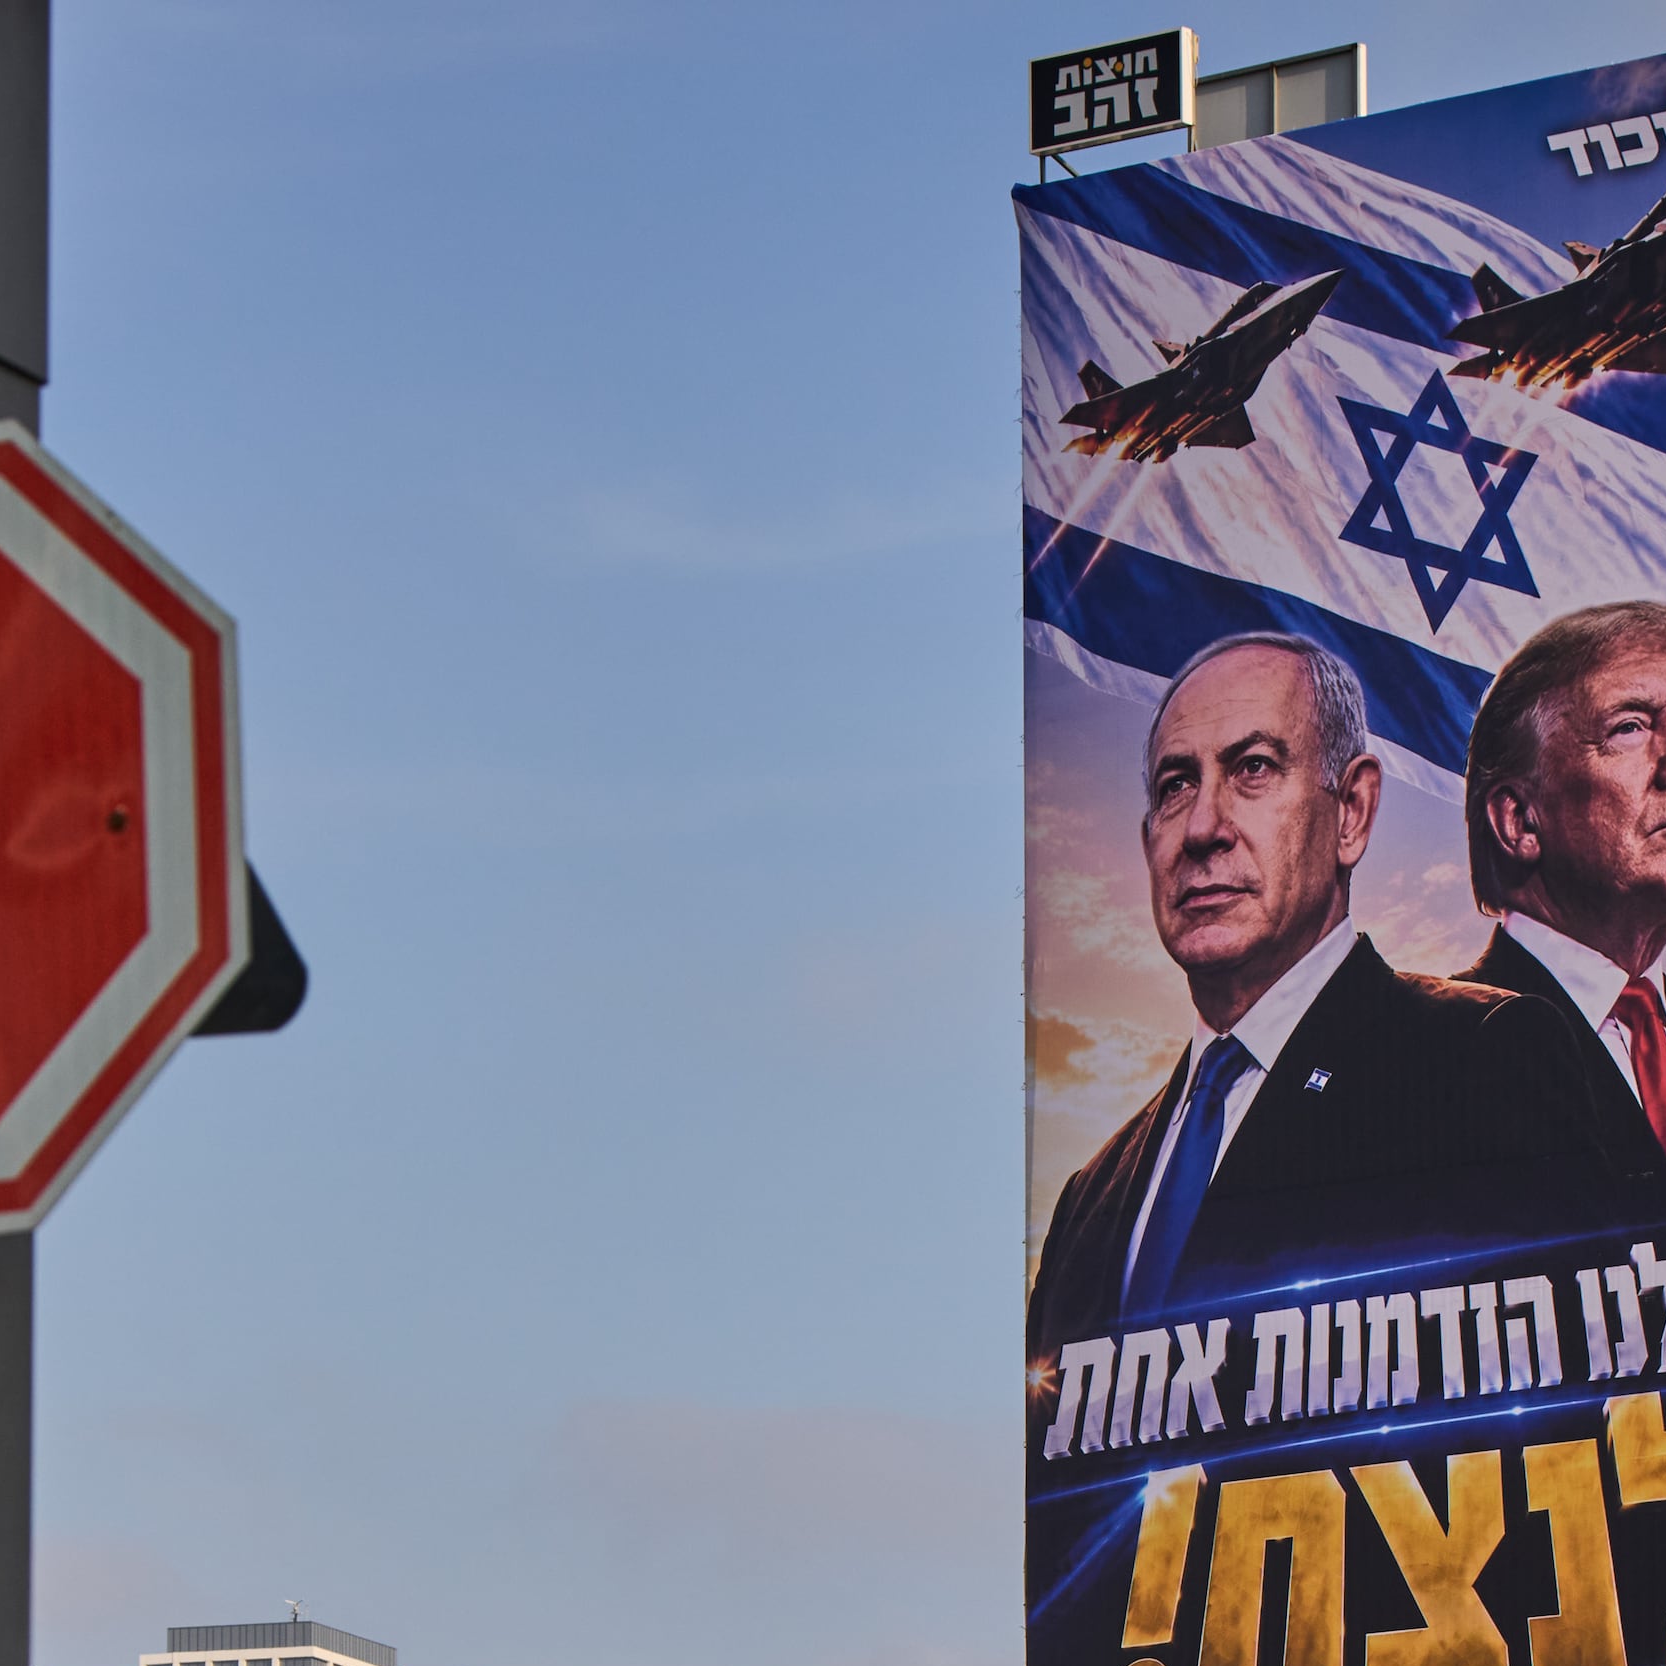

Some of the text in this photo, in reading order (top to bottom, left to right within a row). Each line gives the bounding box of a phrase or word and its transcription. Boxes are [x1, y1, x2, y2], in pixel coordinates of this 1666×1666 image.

[1053, 76, 1159, 137] זהב
[1055, 48, 1158, 91] חוצות
[1044, 1316, 1231, 1461] אחת
[1244, 1274, 1563, 1428] הזדמנות
